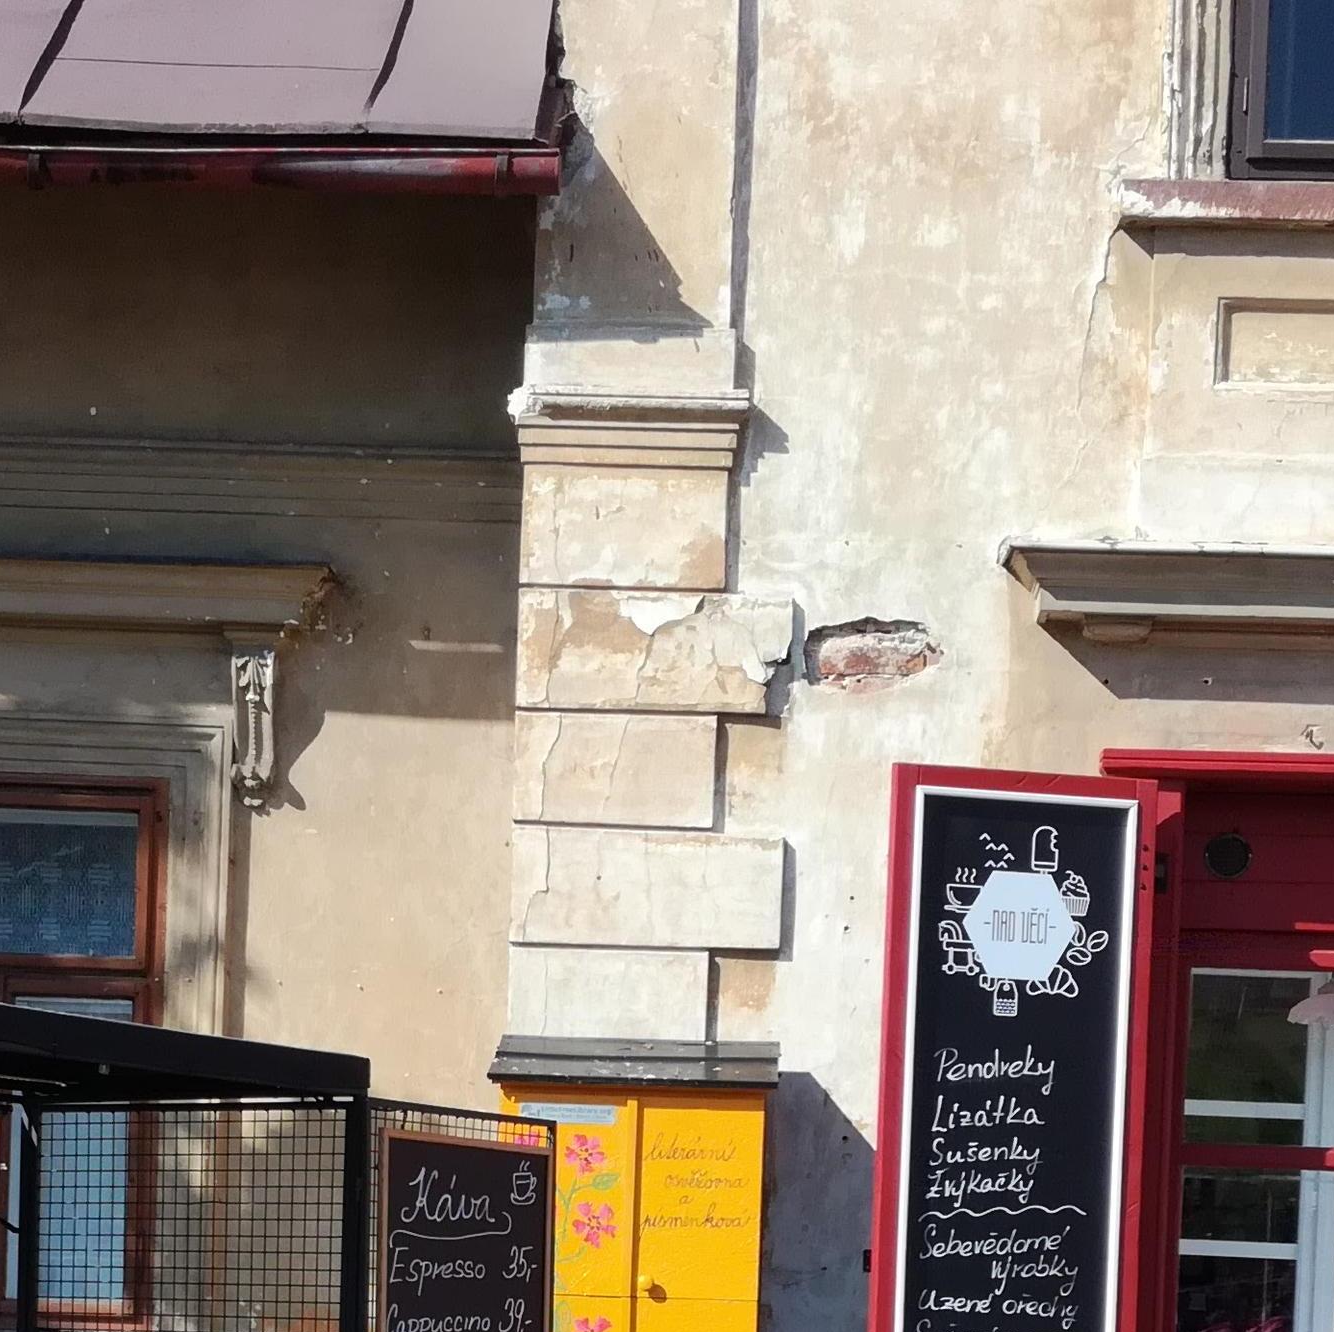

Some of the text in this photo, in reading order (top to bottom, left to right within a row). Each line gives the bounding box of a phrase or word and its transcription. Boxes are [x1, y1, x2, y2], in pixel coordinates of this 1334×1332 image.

[933, 1044, 1055, 1095] Pendreky
[931, 1095, 1045, 1132] Lízátka
[644, 1132, 737, 1161] literární
[929, 1136, 1043, 1175] Sušenky
[401, 1167, 495, 1223] Káva
[925, 1168, 1034, 1207] Žvýkačky
[919, 1223, 1070, 1259] Sebevědomé
[390, 1246, 538, 1296] Espresso 35,-
[918, 1289, 1079, 1330] Uzené ořechy
